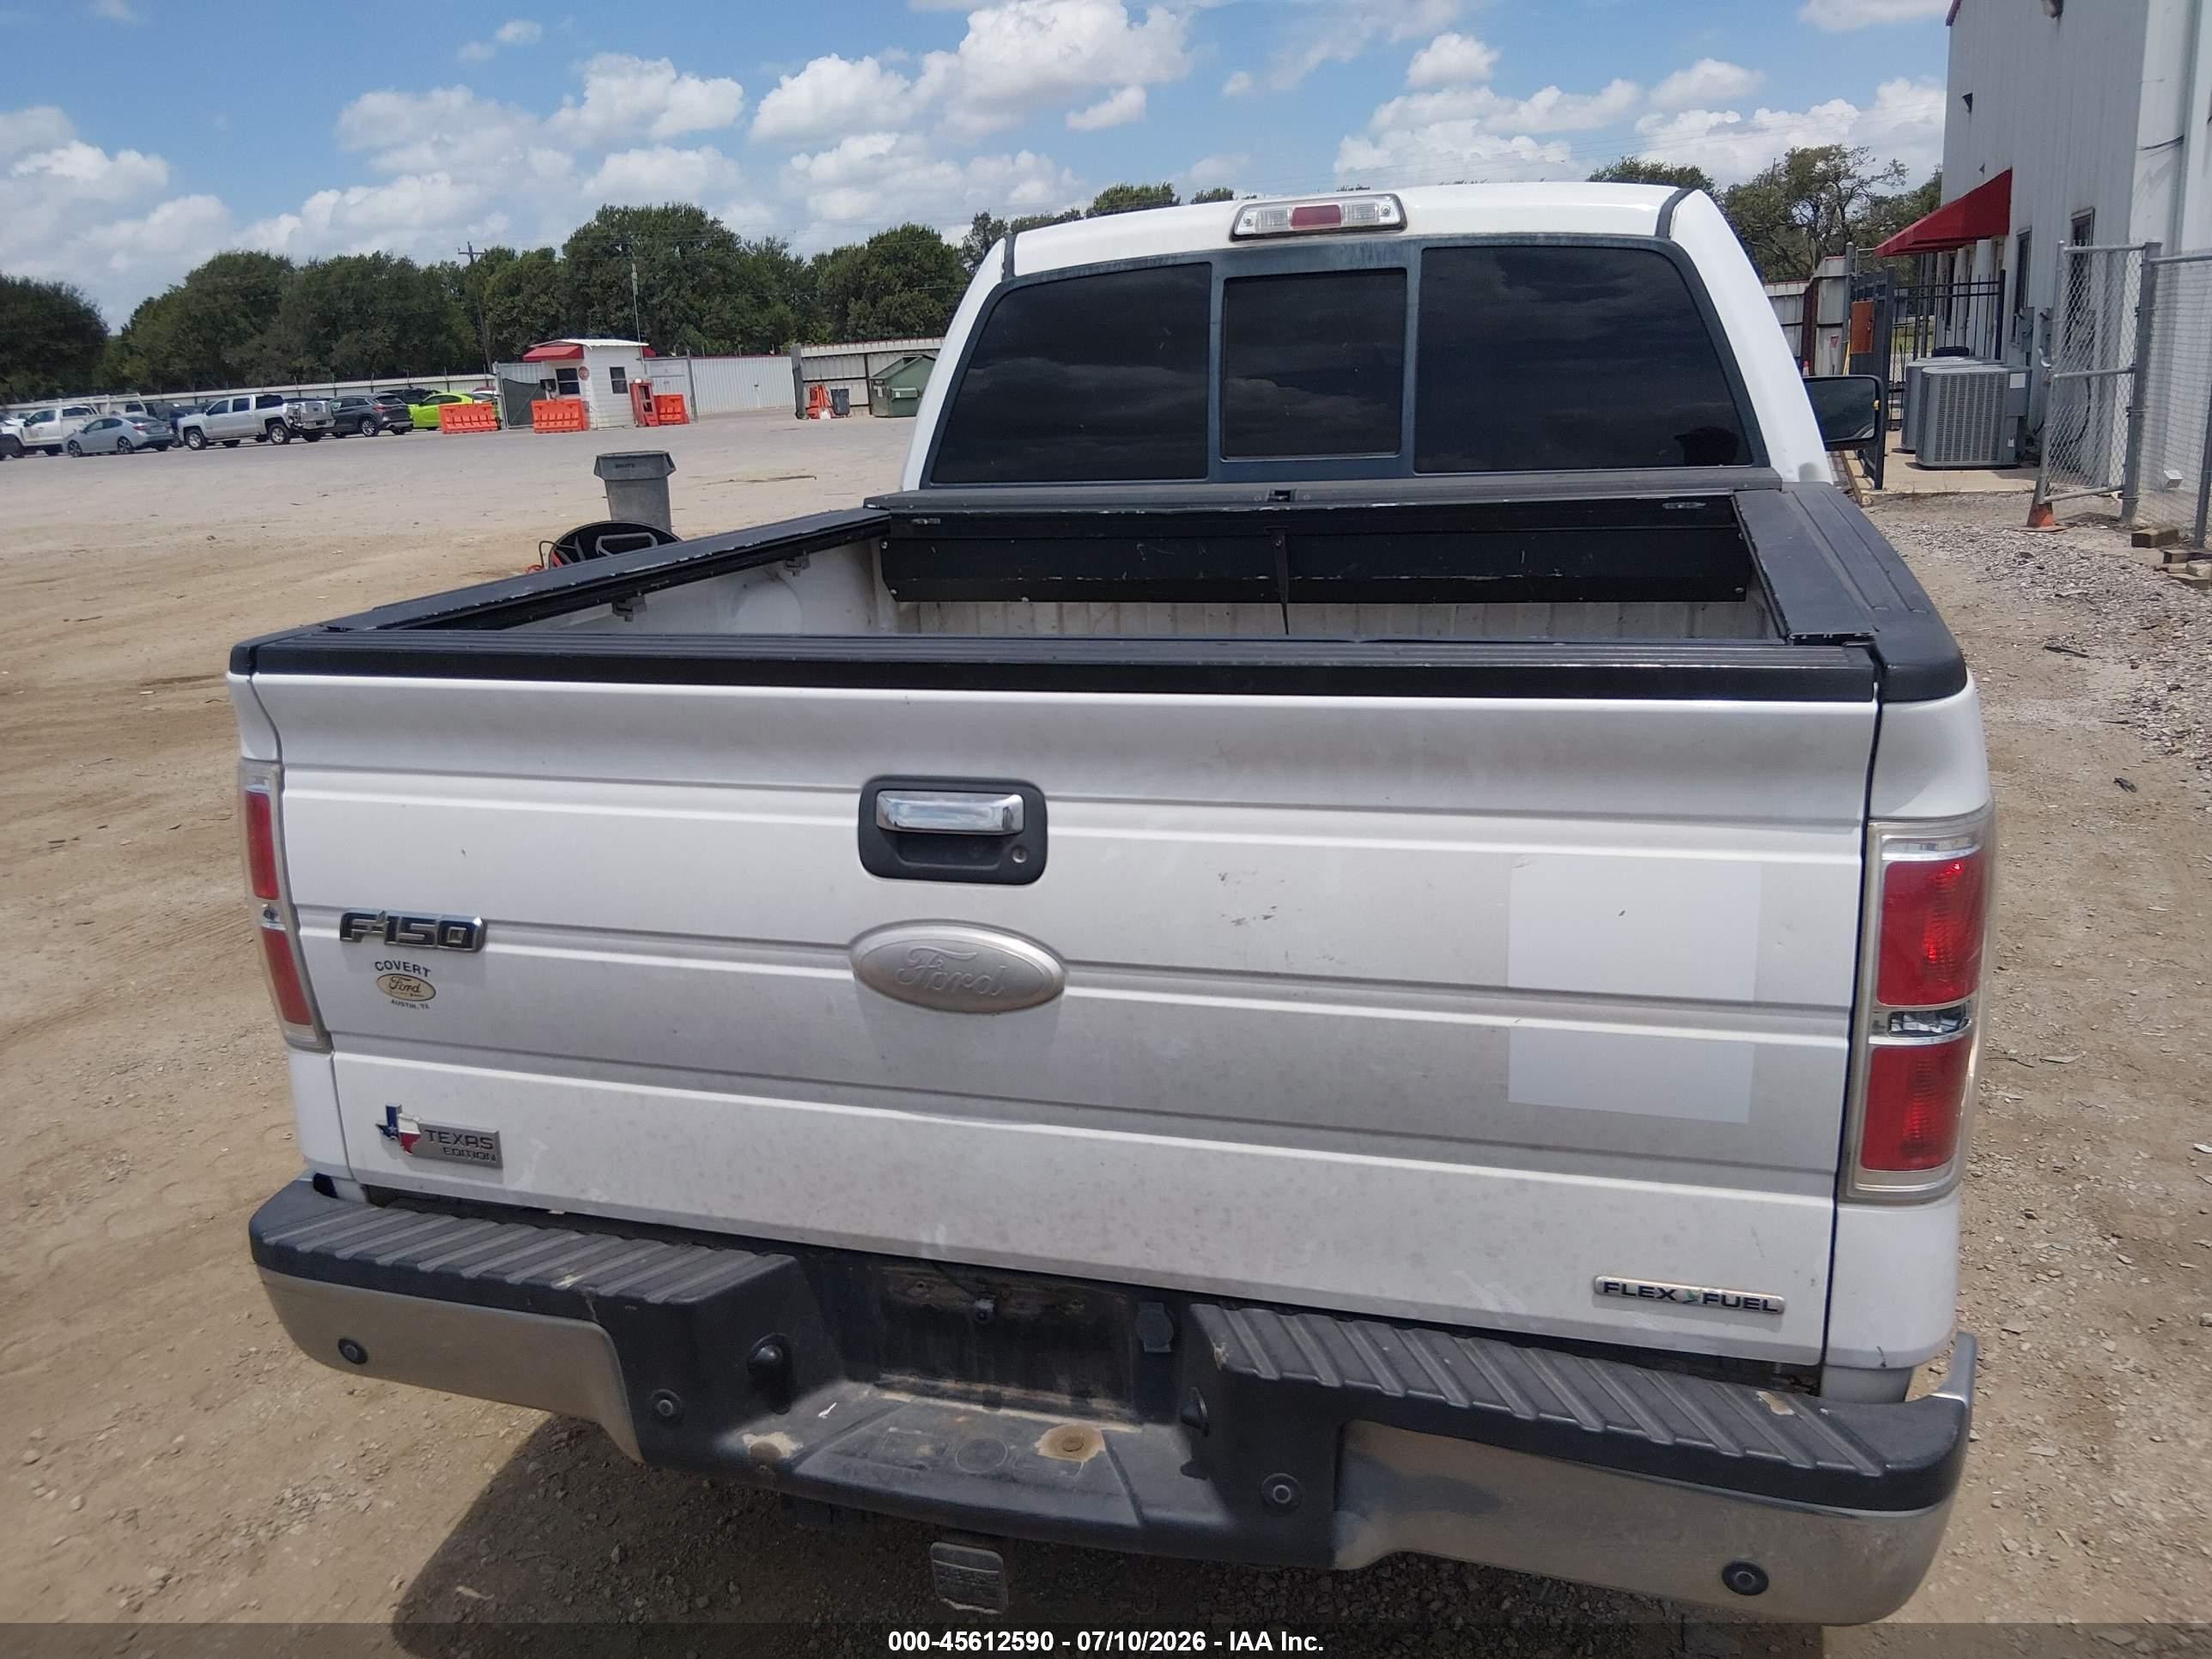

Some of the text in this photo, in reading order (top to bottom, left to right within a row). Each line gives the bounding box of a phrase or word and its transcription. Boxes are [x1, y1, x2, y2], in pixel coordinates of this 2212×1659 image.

[374, 960, 431, 978] COVERT
[896, 945, 1007, 996] Ford
[389, 975, 422, 994] Ford
[424, 1129, 495, 1151] TEXAS
[442, 1146, 496, 1162] EDITION
[1602, 1281, 1778, 1312] FLEX FUEL
